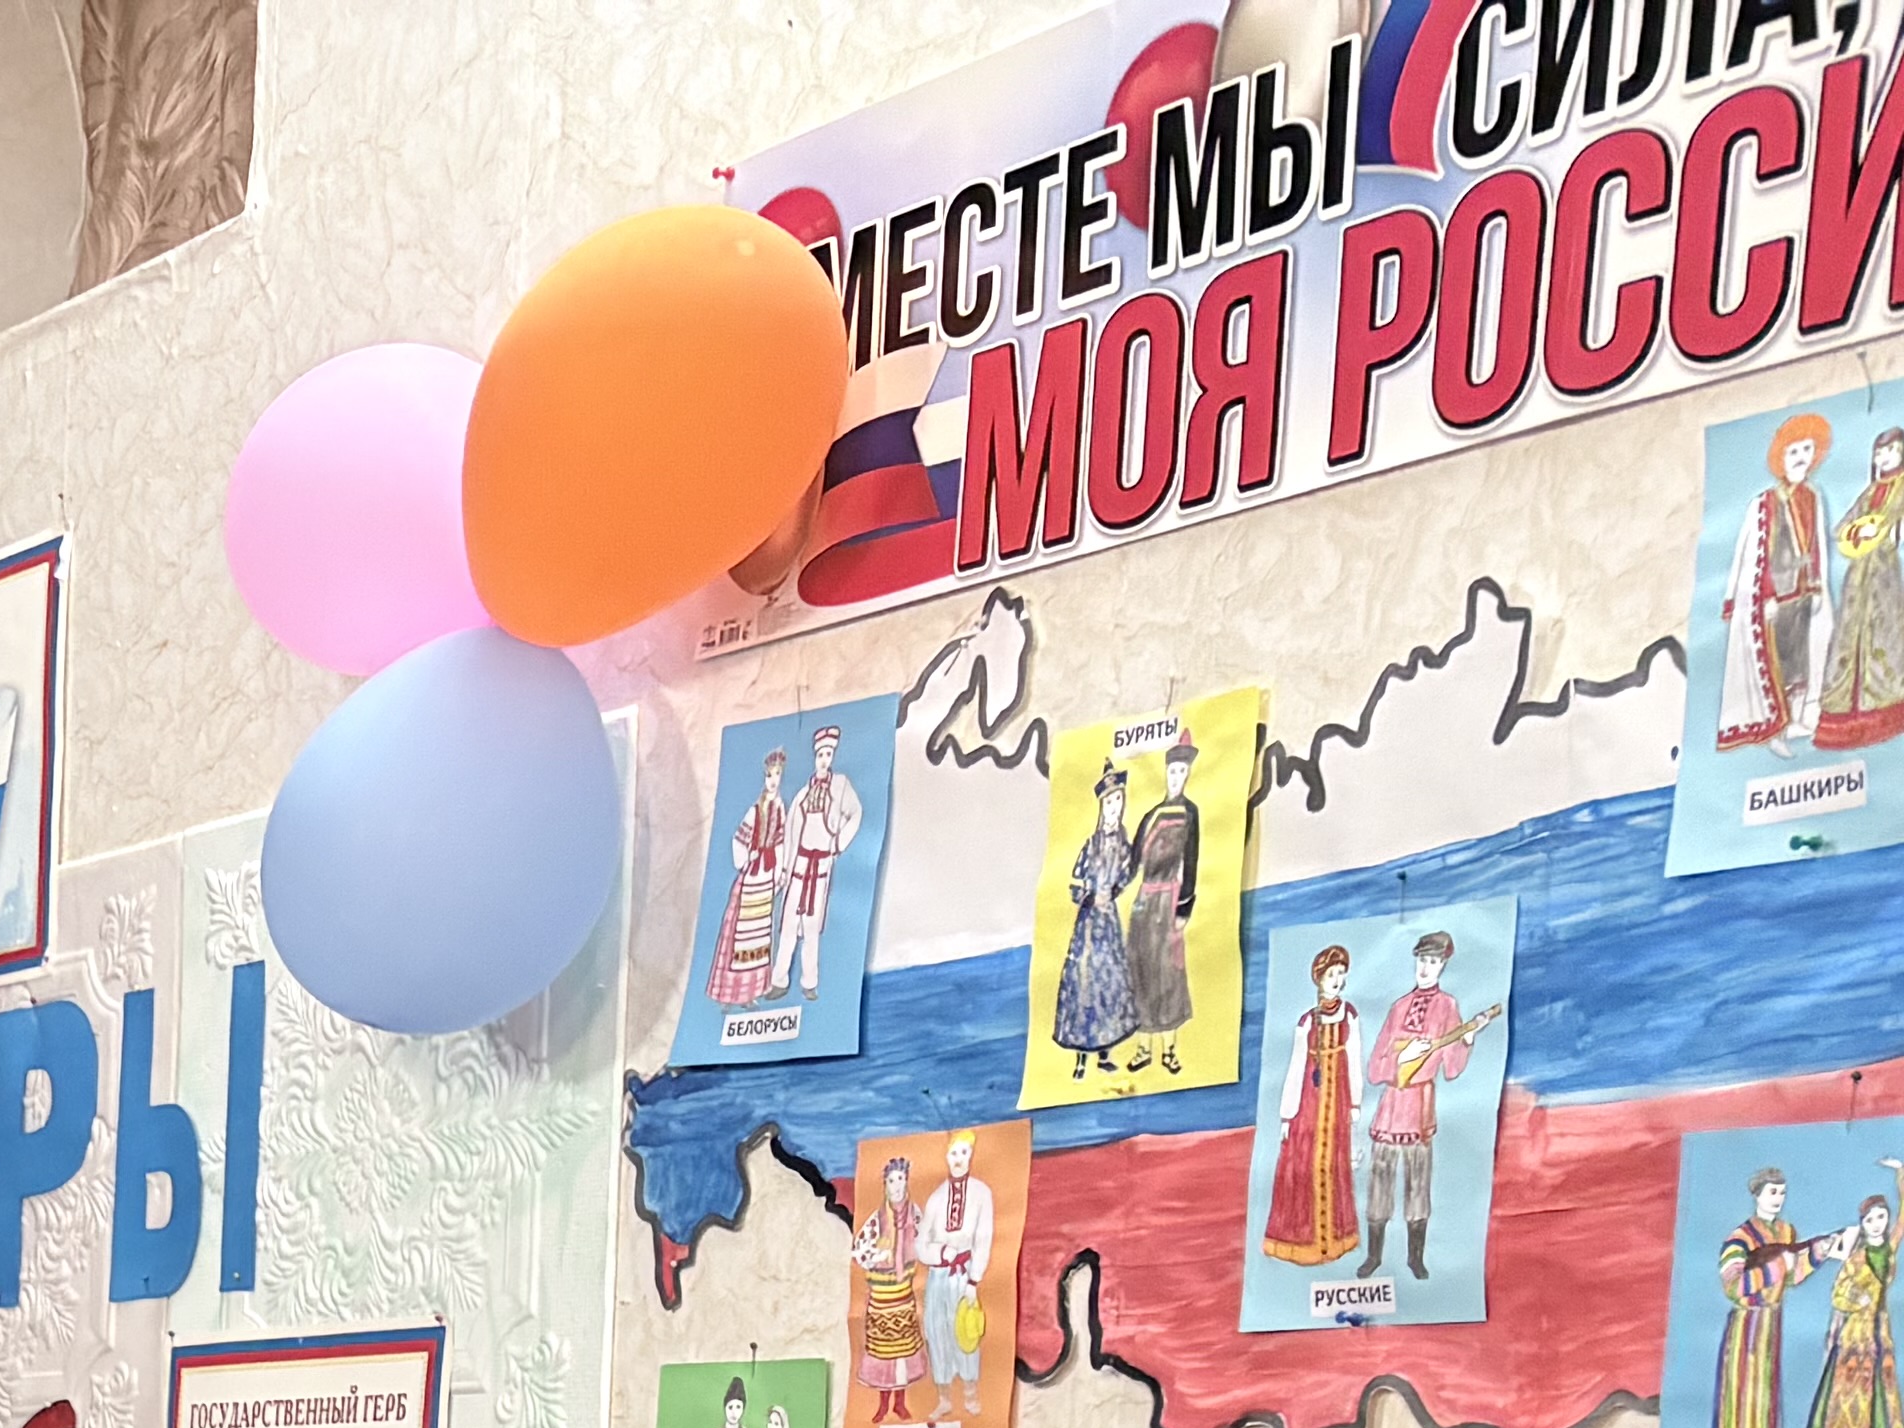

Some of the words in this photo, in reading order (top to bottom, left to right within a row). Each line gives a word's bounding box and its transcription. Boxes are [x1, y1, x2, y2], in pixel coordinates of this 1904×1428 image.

[808, 129, 1120, 372] МЕСТЕ
[1148, 40, 1360, 270] МЫ
[955, 249, 1292, 573] МОЯ
[1326, 55, 1904, 466] РОССИ
[1113, 716, 1178, 749] БУРЯТЫ
[1749, 770, 1864, 811] БАШКИРЫ
[726, 1014, 798, 1037] БЕЛОРУСЫ
[1314, 1284, 1392, 1307] РУССКИЕ
[362, 1393, 408, 1422] ГЕРБ
